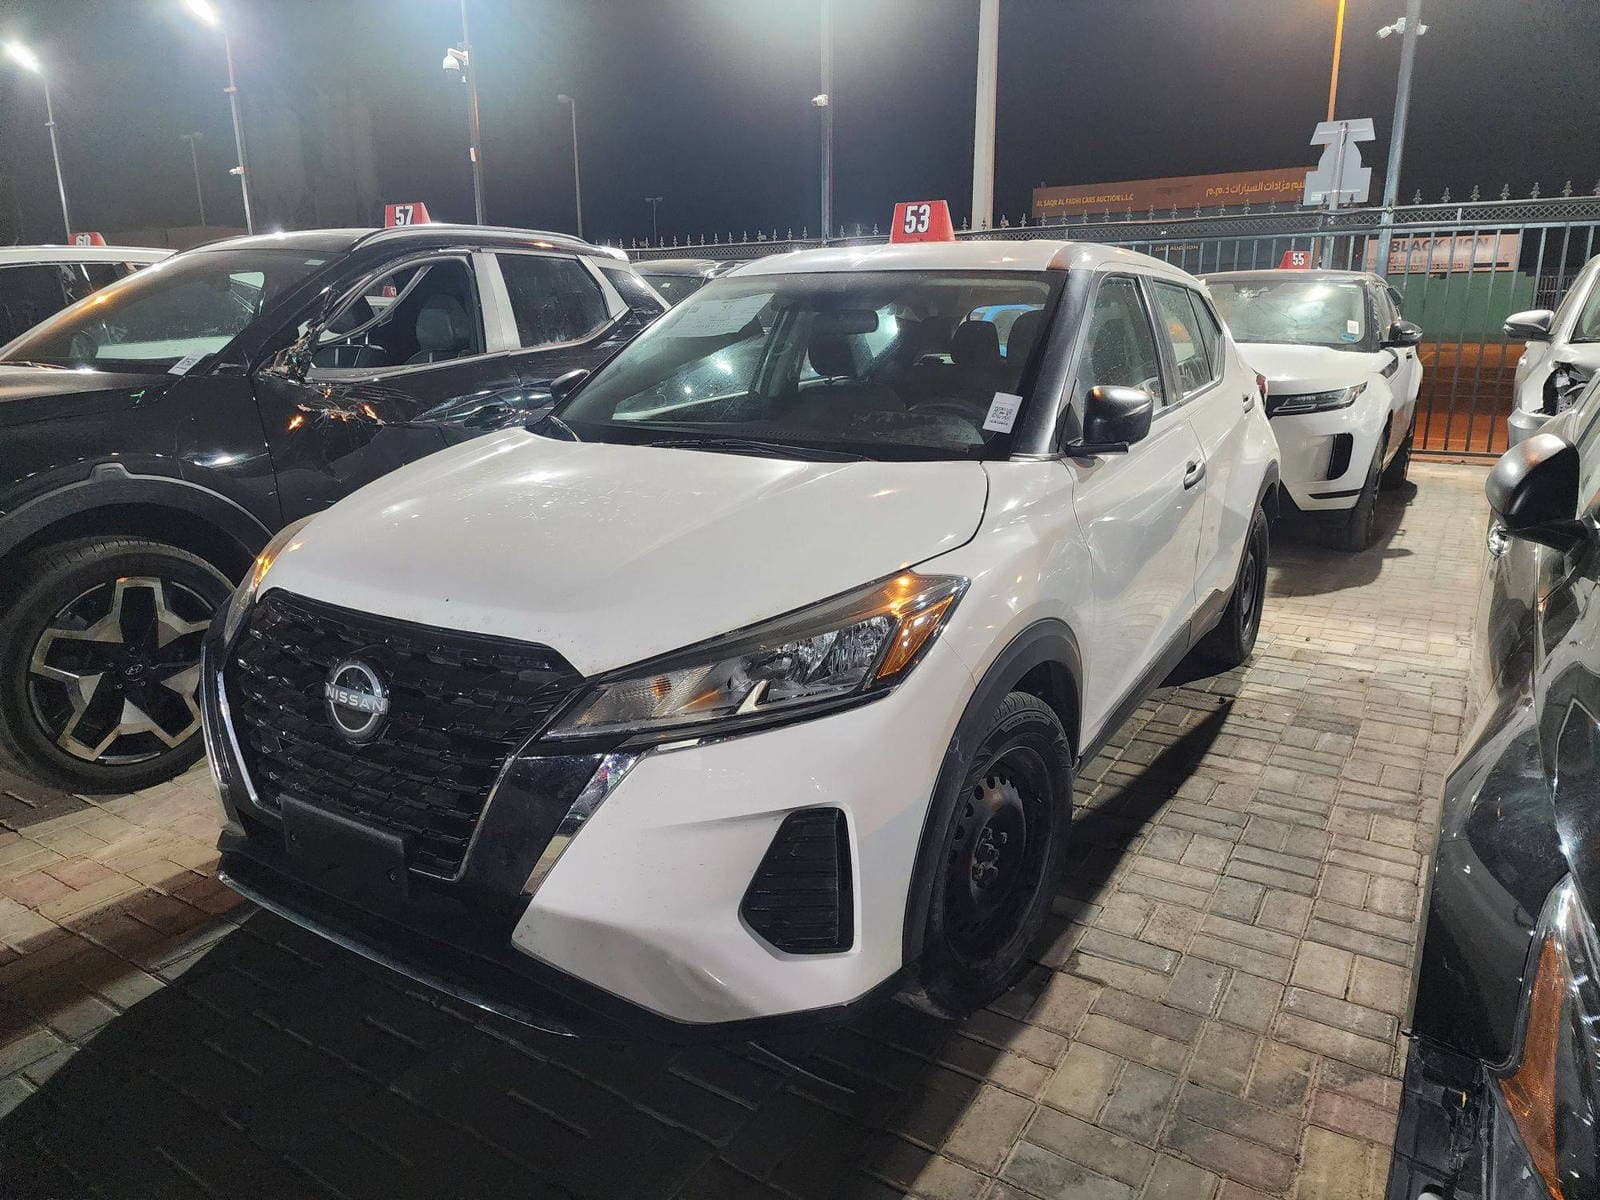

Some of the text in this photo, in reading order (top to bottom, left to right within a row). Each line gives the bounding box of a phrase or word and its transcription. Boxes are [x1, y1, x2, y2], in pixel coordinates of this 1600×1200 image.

[1230, 181, 1263, 195] السيارات
[1097, 194, 1121, 203] AUCTION
[395, 205, 414, 226] 57
[904, 204, 931, 234] 53
[1391, 238, 1447, 253] BLACK
[1292, 252, 1305, 266] 55
[325, 682, 385, 712] NISSAN
